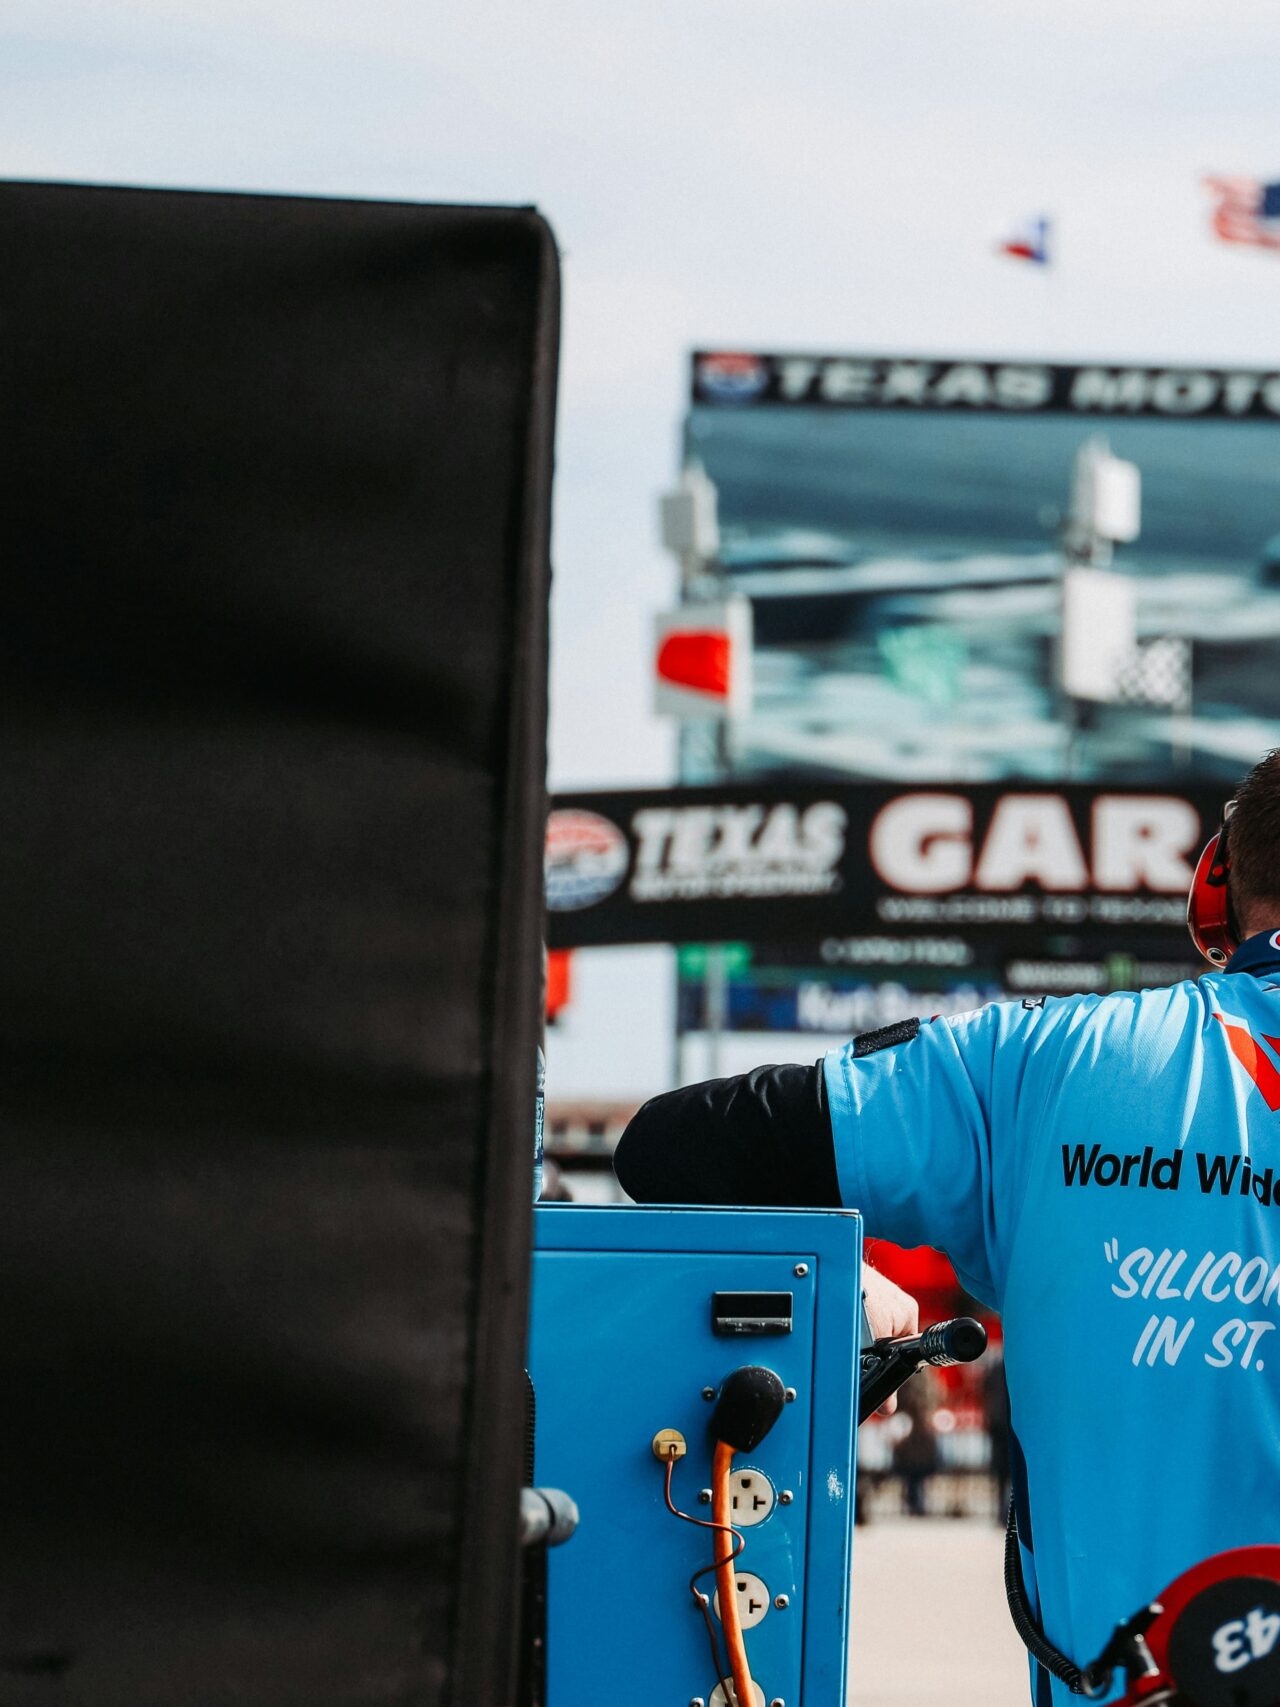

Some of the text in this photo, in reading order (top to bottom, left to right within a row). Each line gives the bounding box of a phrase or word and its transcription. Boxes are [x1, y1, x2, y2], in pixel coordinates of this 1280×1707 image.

[778, 360, 1053, 408] TEXAS
[631, 801, 849, 874] TEXAS
[1061, 1142, 1183, 1190] World
[1131, 1314, 1195, 1367] IN
[1204, 1320, 1277, 1373] ST.
